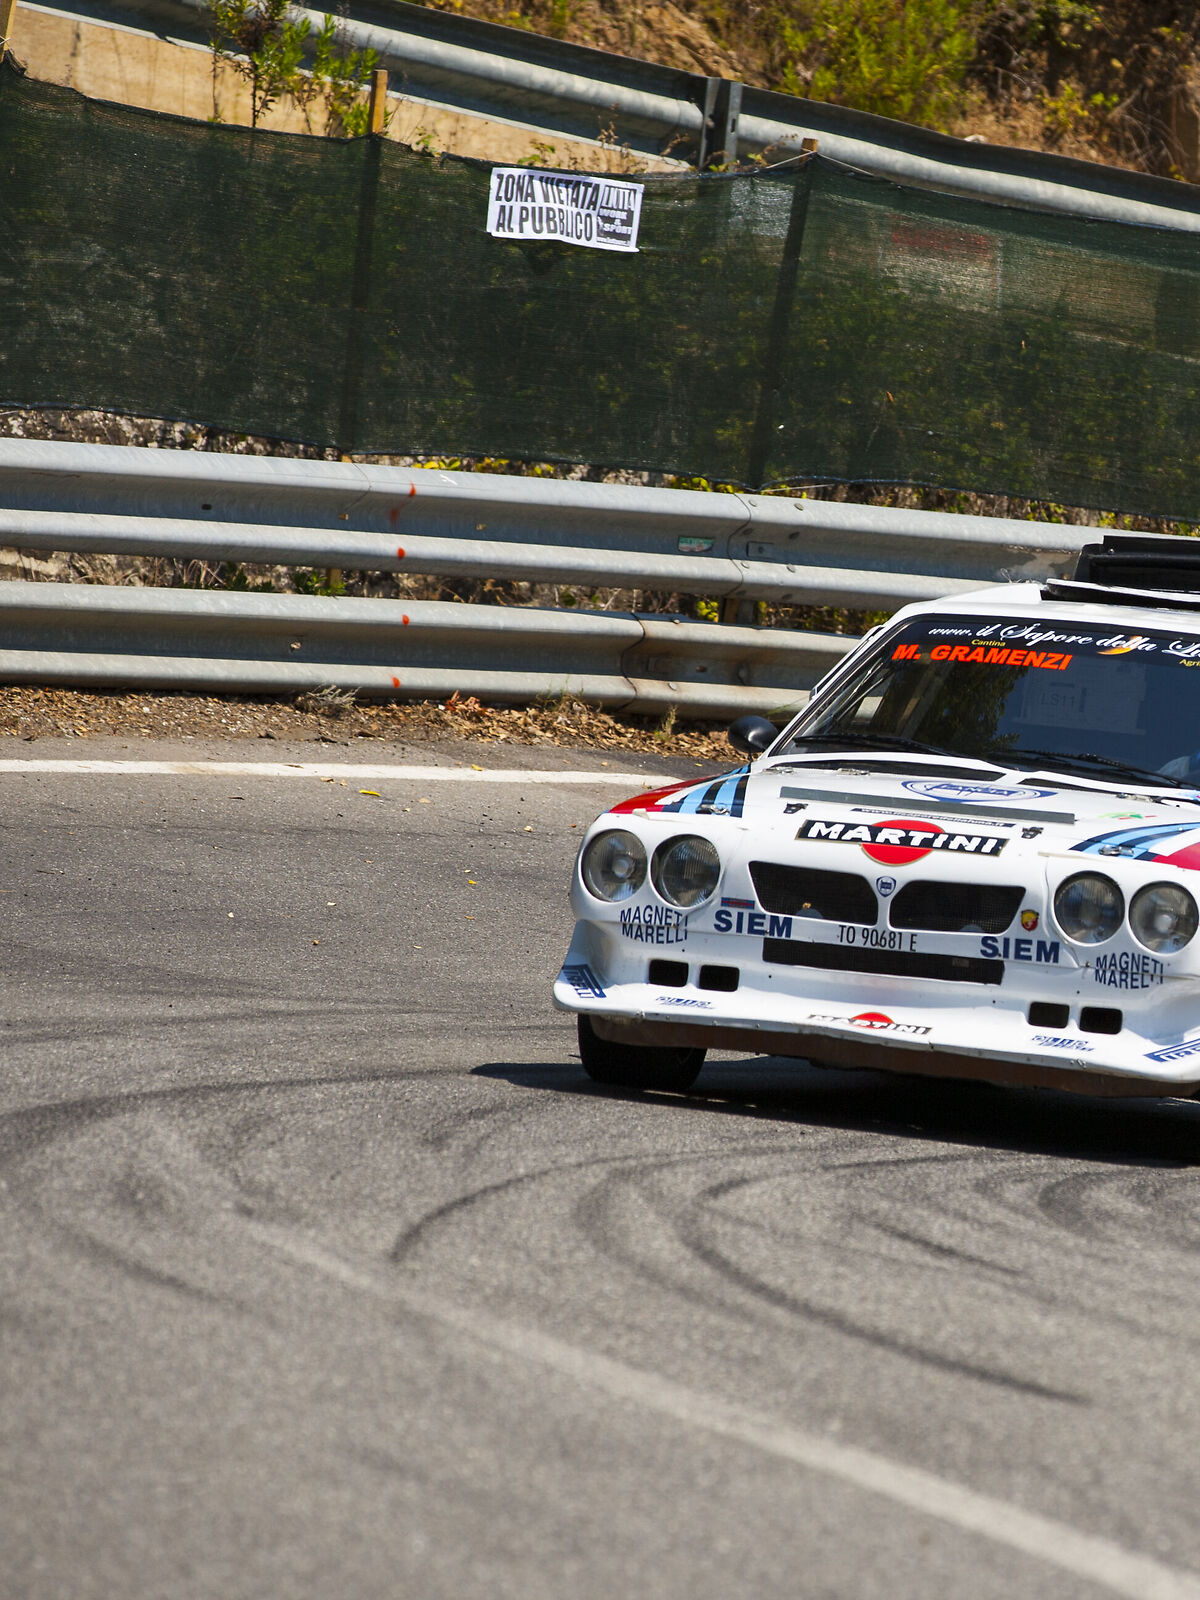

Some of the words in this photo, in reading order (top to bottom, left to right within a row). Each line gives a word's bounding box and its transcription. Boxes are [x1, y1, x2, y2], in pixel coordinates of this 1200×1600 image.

[495, 173, 535, 203] ZONA
[539, 176, 600, 211] VIETATA
[496, 205, 514, 233] AL
[519, 206, 593, 242] PUBBLICO
[971, 638, 1006, 648] Cantina
[1000, 623, 1093, 647] Sapore
[1096, 634, 1158, 651] della
[892, 644, 922, 661] M.
[930, 645, 1073, 671] GRAMENZI
[807, 821, 999, 853] MARTINI
[620, 905, 688, 928] MAGNETI
[714, 910, 793, 938] SIEM
[622, 923, 688, 945] MARELLI
[839, 925, 855, 944] TO
[861, 928, 902, 950] 90681
[910, 934, 917, 951] E
[980, 936, 1060, 963] SIEM
[1096, 952, 1163, 975] MAGNETI
[562, 964, 607, 998] PIRELLI
[1095, 968, 1163, 989] MARELLI
